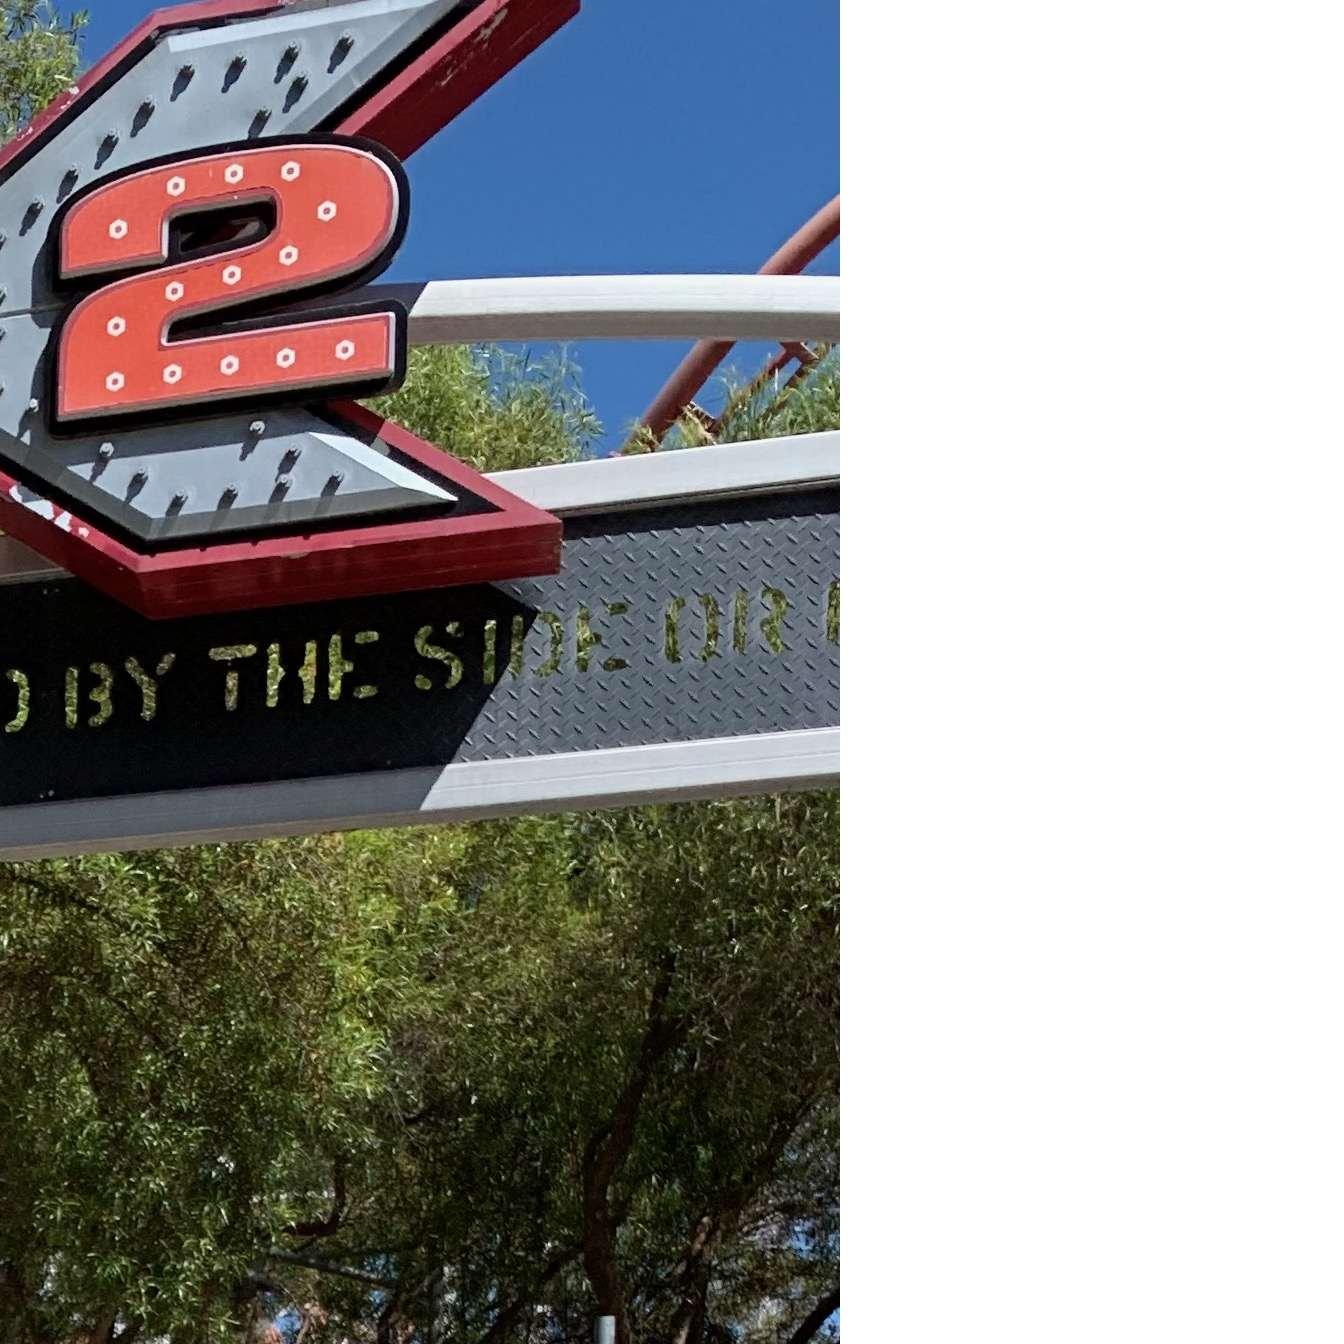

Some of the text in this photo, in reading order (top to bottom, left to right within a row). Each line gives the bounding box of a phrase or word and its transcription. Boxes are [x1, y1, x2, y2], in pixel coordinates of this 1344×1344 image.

[64, 651, 177, 730] BY
[209, 630, 379, 711] THE
[415, 602, 630, 690] SIDE
